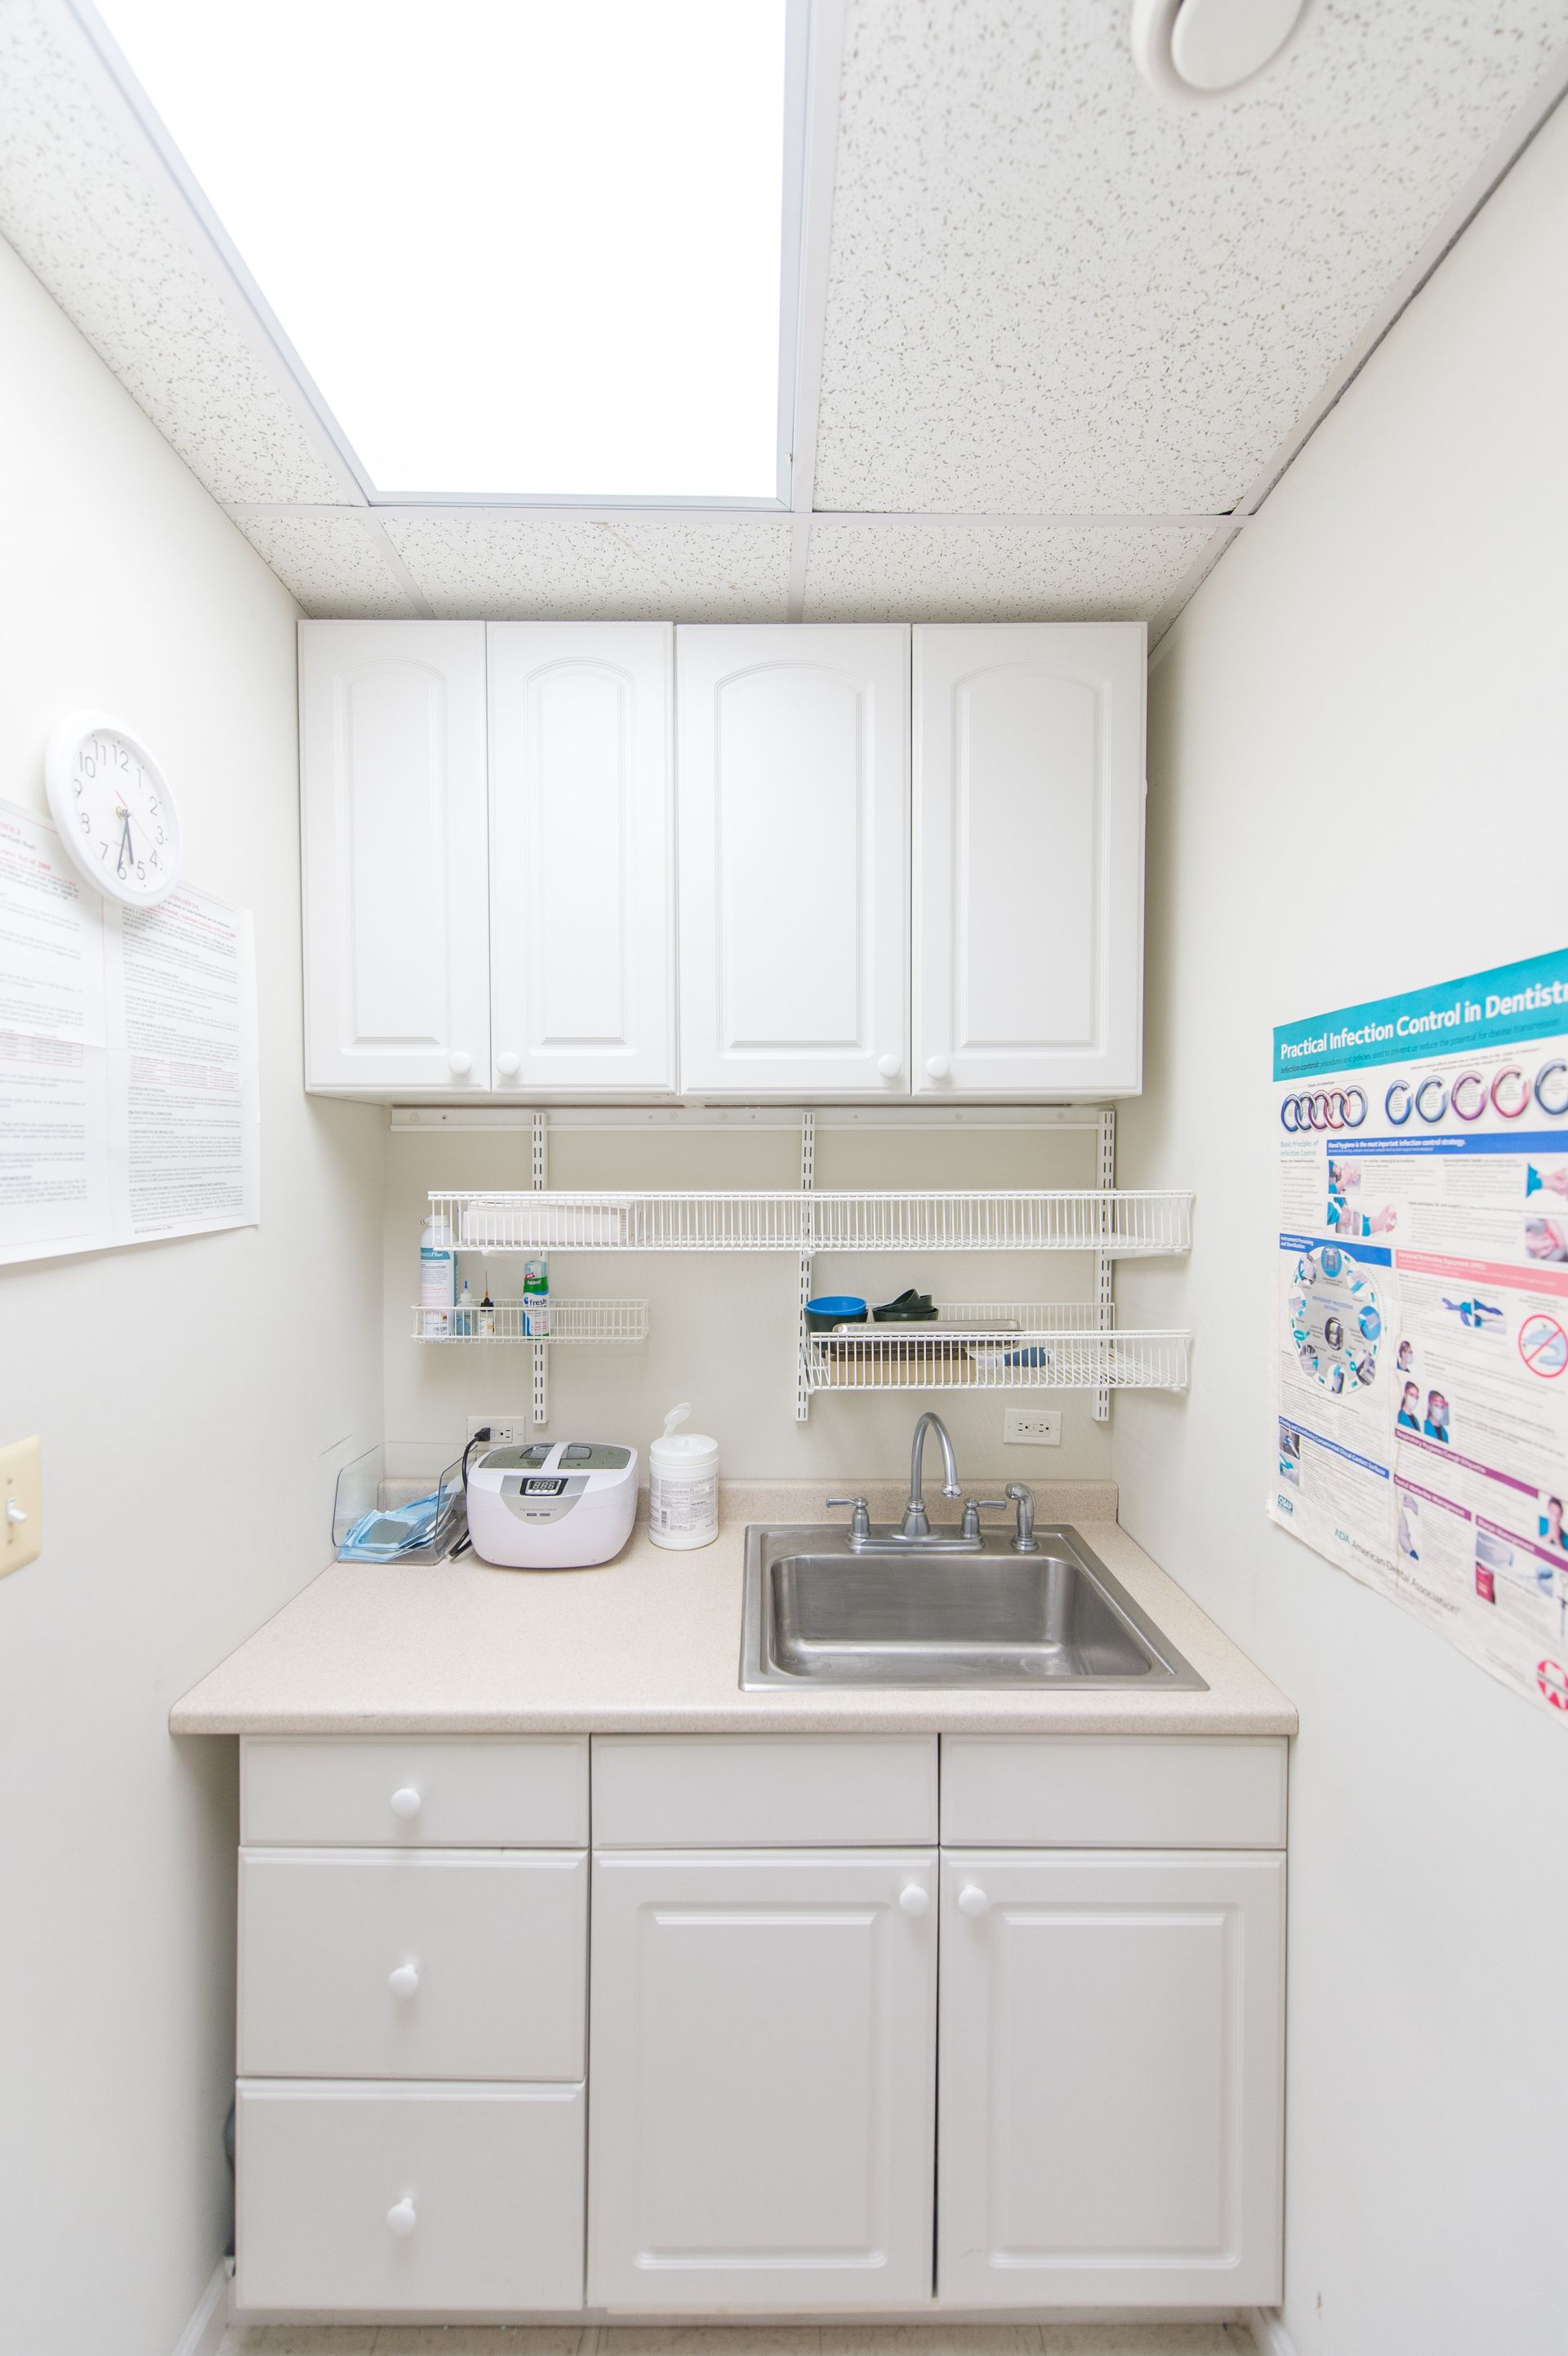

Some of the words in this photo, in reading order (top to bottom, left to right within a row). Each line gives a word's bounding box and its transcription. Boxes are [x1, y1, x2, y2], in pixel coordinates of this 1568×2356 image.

[79, 750, 96, 778] 10
[93, 740, 106, 767] 11
[112, 744, 129, 773] 12
[137, 767, 141, 788] 1
[74, 778, 82, 799] 9
[150, 795, 158, 817] 2
[157, 825, 164, 844] 3
[100, 841, 109, 861] 7
[149, 849, 158, 869] 4
[118, 859, 127, 880] 6
[136, 860, 145, 880] 5
[1281, 1033, 1327, 1060] Practical
[1330, 1022, 1393, 1049] Infection
[1396, 1003, 1461, 1036] Control
[1464, 1000, 1481, 1023] in
[1281, 1064, 1300, 1074] Infection
[1343, 1056, 1352, 1064] and
[1352, 1053, 1371, 1063] policies
[1439, 1038, 1449, 1047] the
[529, 1298, 547, 1306] fresh
[1352, 1540, 1385, 1566] American
